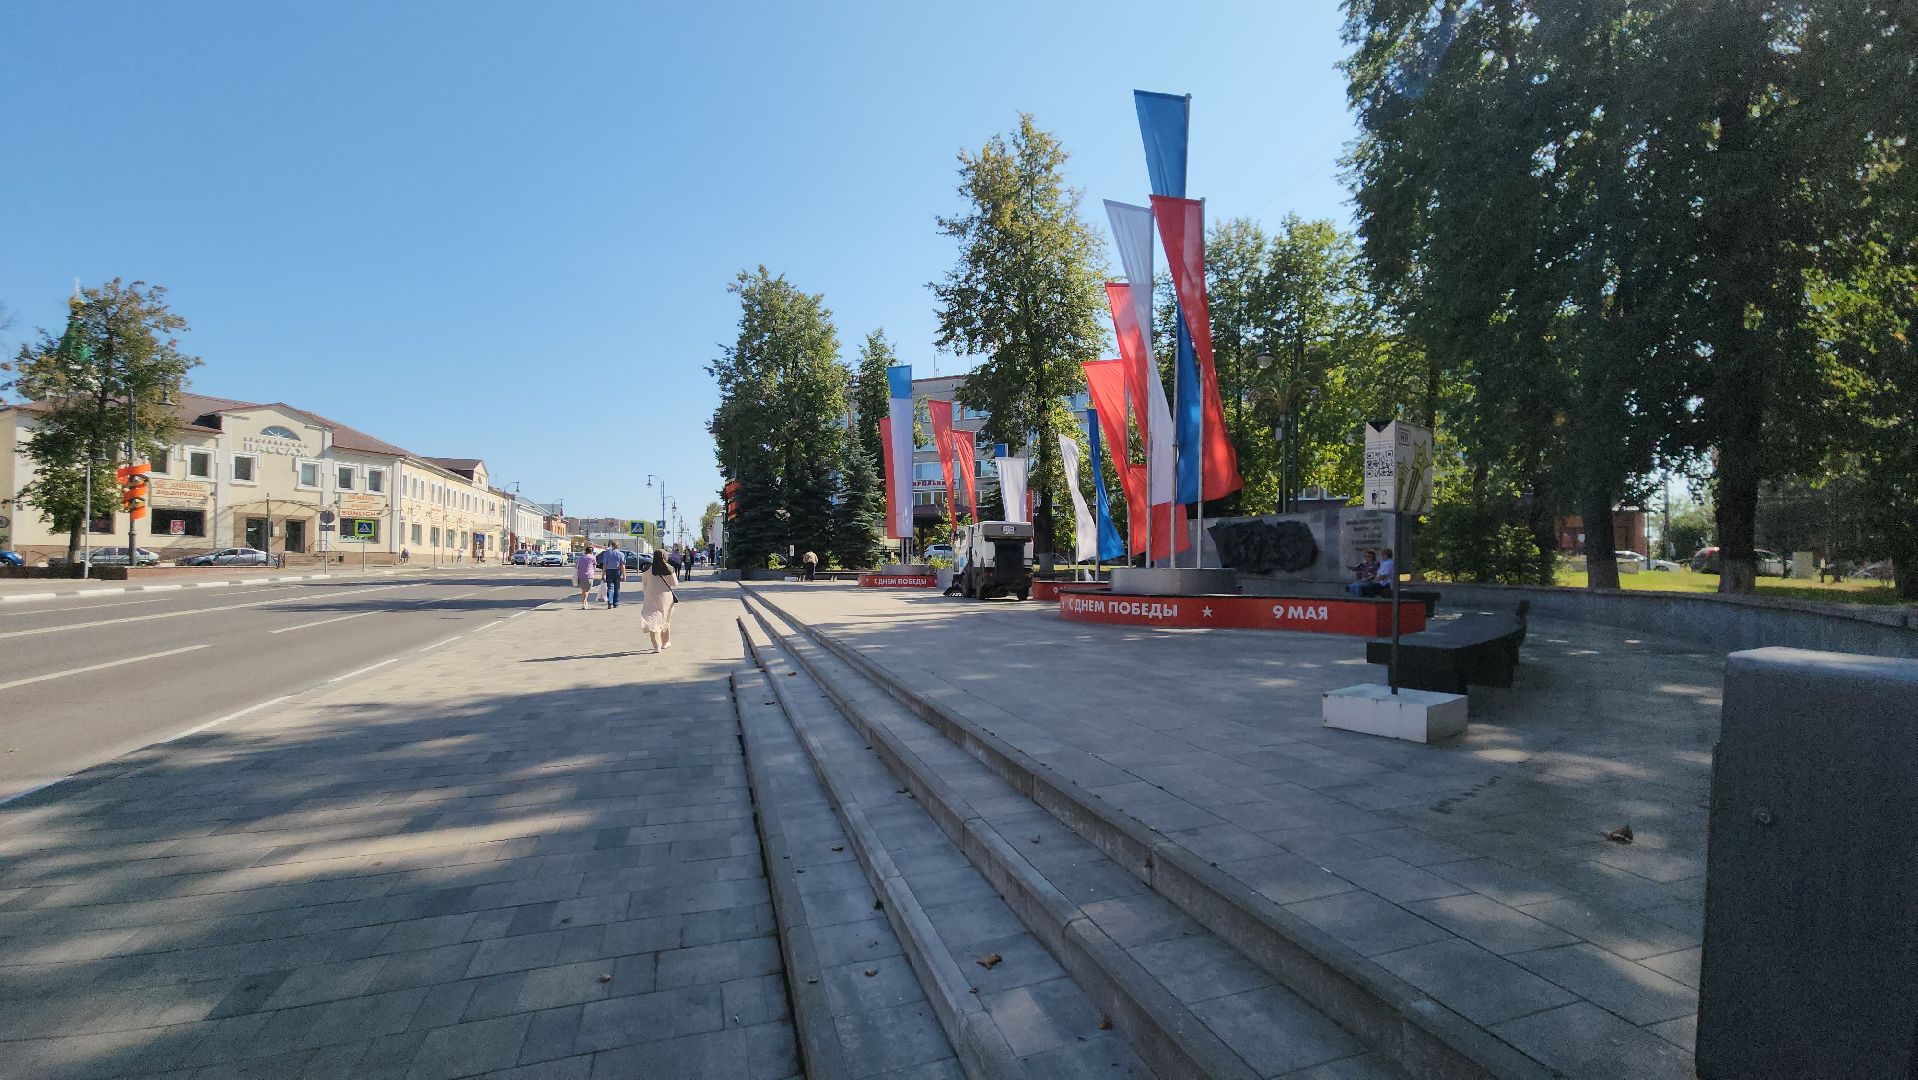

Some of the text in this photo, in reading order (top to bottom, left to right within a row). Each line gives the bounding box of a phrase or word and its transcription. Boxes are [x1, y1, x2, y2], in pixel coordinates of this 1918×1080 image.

[1068, 598, 1075, 611] С
[1075, 598, 1105, 614] ДНЕМ
[1108, 601, 1178, 619] ПОБЕДЫ
[1272, 604, 1328, 620] 9 МАЯ
